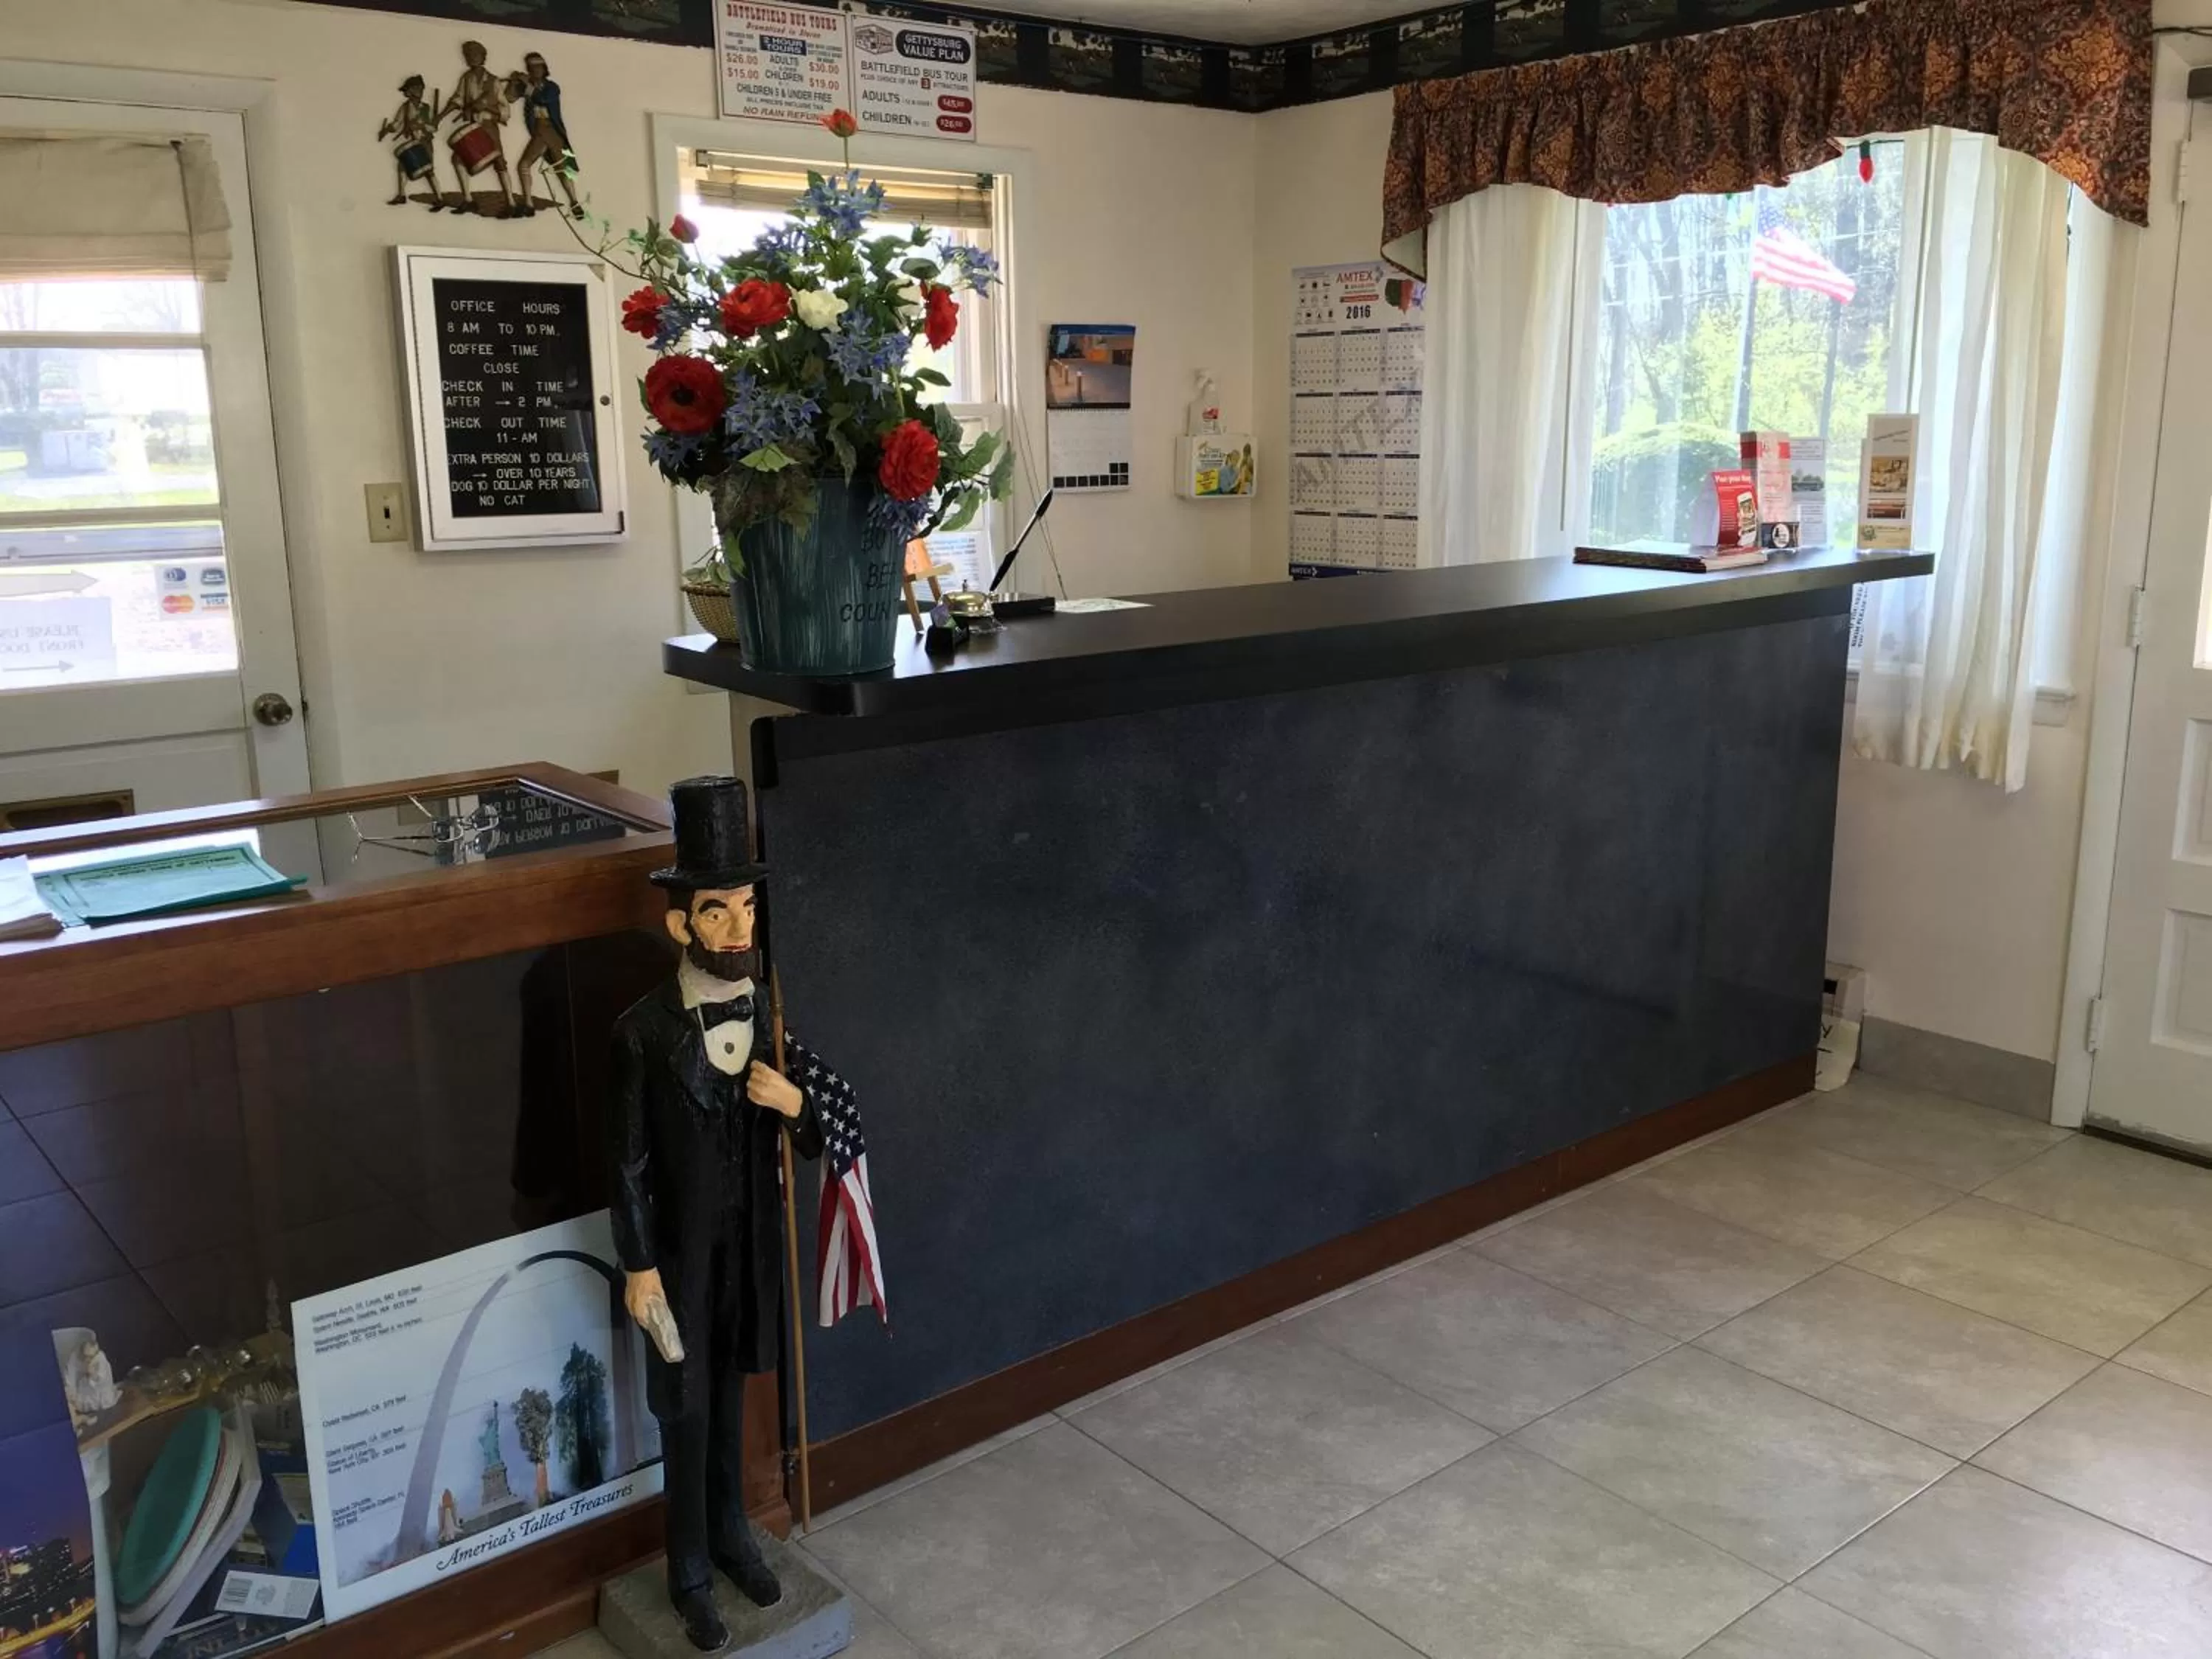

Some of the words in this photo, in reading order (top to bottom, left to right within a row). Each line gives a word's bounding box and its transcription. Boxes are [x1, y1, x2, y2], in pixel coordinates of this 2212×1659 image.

[727, 3, 787, 24] BATTLEFIELD
[790, 11, 806, 27] BUS
[809, 15, 837, 31] TOURS
[772, 38, 803, 47] HOUR
[905, 32, 962, 49] GETTYSBURG
[767, 44, 802, 54] TOURS
[903, 44, 936, 58] VALUE
[939, 49, 964, 61] PLAN
[726, 52, 759, 66] $26.00
[770, 54, 800, 67] ADULTS
[808, 61, 840, 74] $30.00
[860, 60, 921, 76] BATTLEFIELD
[922, 69, 942, 80] BUS
[944, 71, 969, 82] TOUR
[765, 69, 804, 83] CHILDREN
[809, 77, 840, 91] $19.00
[737, 82, 773, 97] CHILDREN
[787, 89, 812, 101] UNDER
[813, 91, 832, 103] FREE
[862, 89, 900, 104] ADULTS
[743, 105, 759, 114] NO
[760, 108, 785, 118] RAIN
[862, 111, 912, 125] CHILDREN
[1336, 271, 1373, 283] AMTEX
[451, 300, 495, 313] OFFICE
[523, 303, 560, 315] HOURS
[1346, 305, 1371, 319] 2016
[447, 322, 455, 333] 8
[462, 322, 480, 334] AM
[498, 323, 514, 335] TO
[526, 324, 537, 335] 10
[449, 344, 495, 355] COFFEE
[510, 344, 540, 356] TIME
[483, 362, 520, 375] CLOSE
[442, 380, 484, 392] CHECK
[501, 381, 514, 392] IN
[536, 380, 564, 392] TIME
[445, 396, 481, 408] AFTER
[518, 397, 526, 407] 2
[445, 417, 481, 428] CHECK
[501, 417, 524, 428] OUT
[538, 417, 566, 428] TIME
[497, 432, 508, 443] 11
[521, 432, 538, 443] AM
[448, 453, 478, 465] EXTRA
[481, 453, 522, 465] PERSON
[529, 453, 540, 464] 10
[547, 452, 590, 463] DOLLARS
[496, 468, 524, 479] OVER
[529, 468, 542, 479] 10
[545, 467, 576, 479] YEARS
[451, 481, 473, 492] DOG
[477, 481, 487, 492] 10
[493, 479, 534, 491] DOLLAR
[538, 479, 559, 490] PER
[563, 479, 591, 490] NIGHT
[479, 495, 495, 507] NO
[504, 495, 526, 506] CAT
[436, 1526, 515, 1571] America's
[519, 1508, 566, 1538] Tallest
[569, 1484, 634, 1517] Treasures
